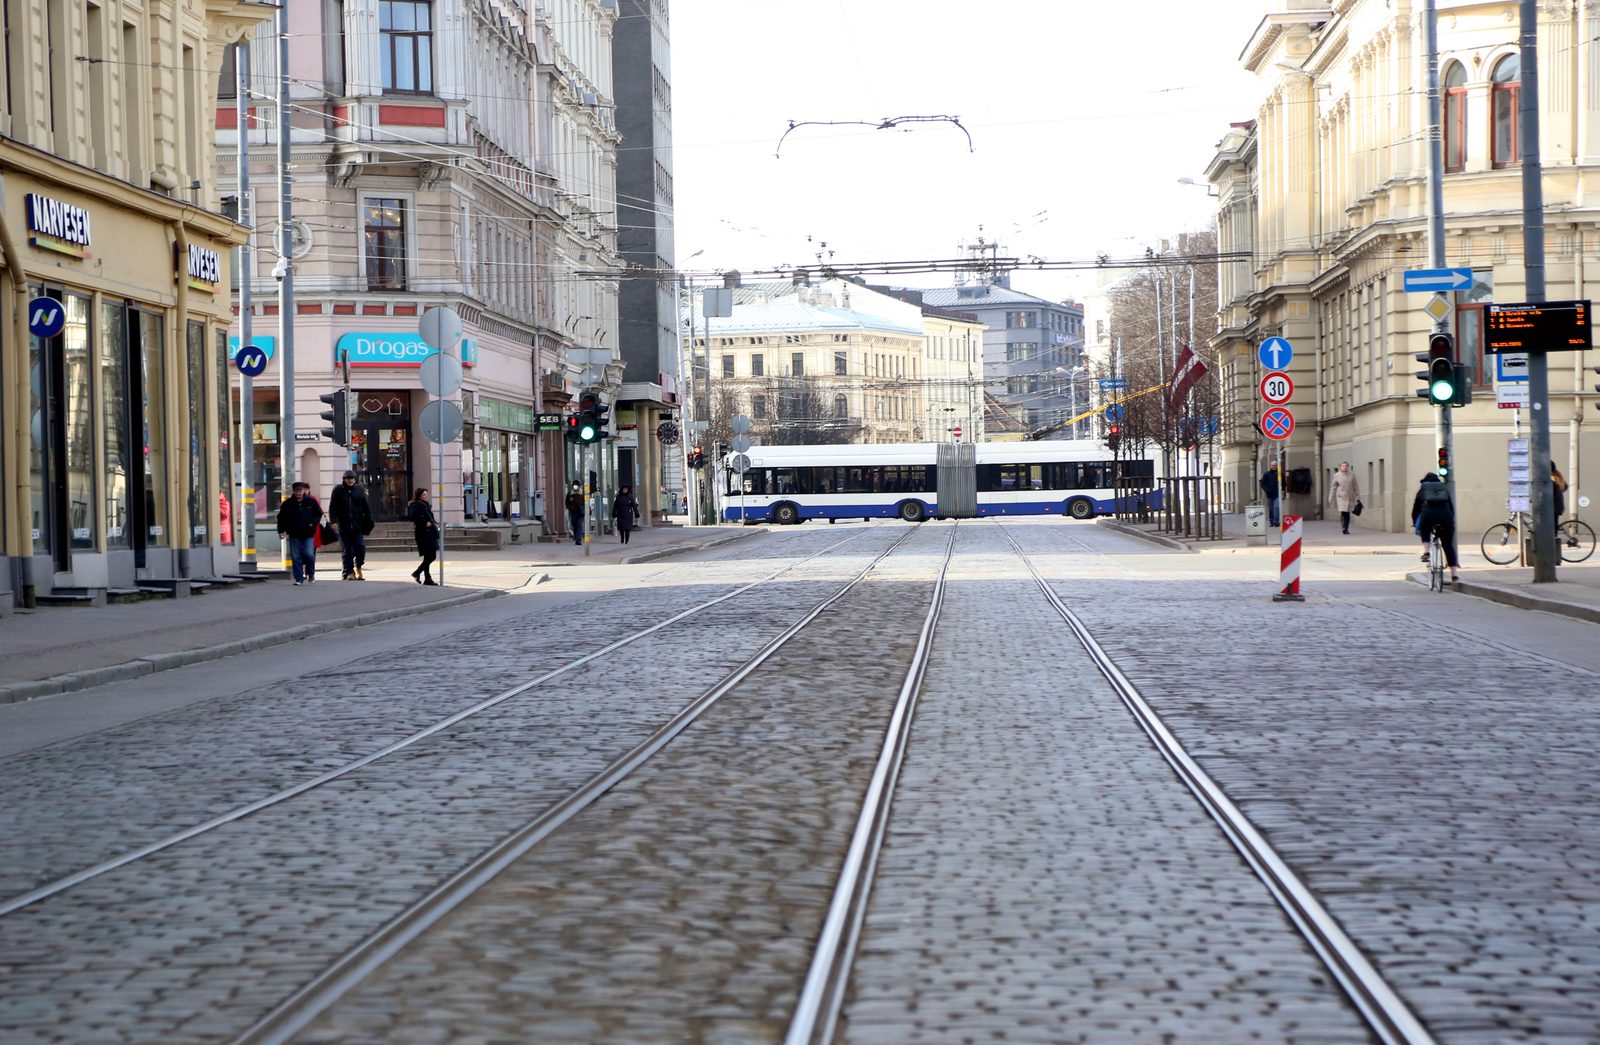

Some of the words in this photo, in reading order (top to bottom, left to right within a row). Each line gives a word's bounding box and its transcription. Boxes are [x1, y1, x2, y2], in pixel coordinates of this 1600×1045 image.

[32, 193, 91, 246] NARVESEN
[356, 338, 429, 359] Drogas
[1268, 381, 1285, 396] 30
[539, 415, 559, 423] SEB
